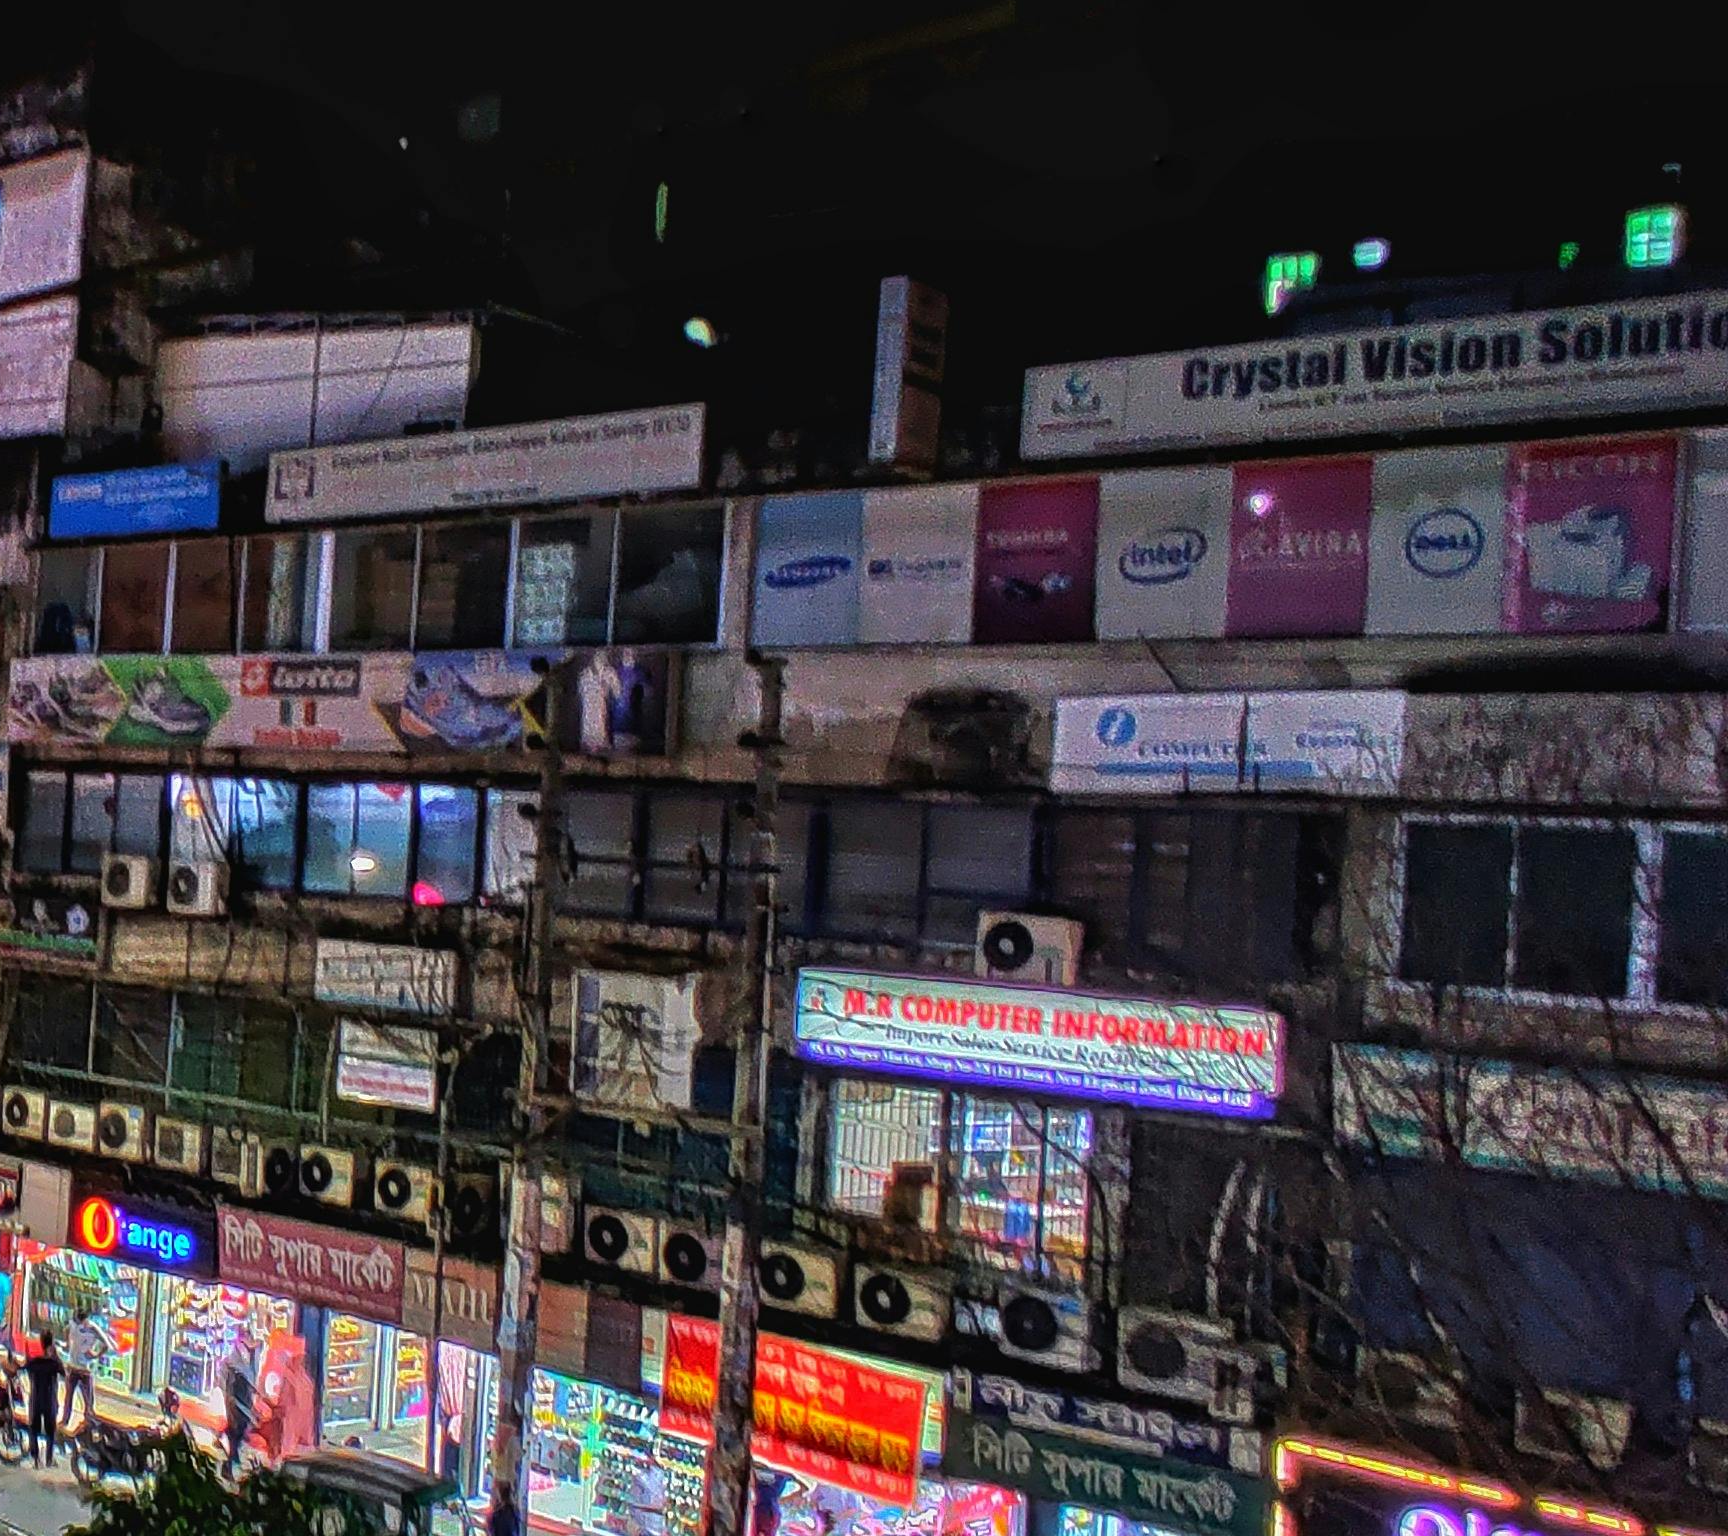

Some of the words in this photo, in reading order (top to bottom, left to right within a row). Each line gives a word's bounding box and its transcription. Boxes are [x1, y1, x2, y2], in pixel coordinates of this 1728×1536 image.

[1180, 344, 1347, 402] Crystal
[1362, 328, 1522, 382] Vision
[901, 993, 1042, 1036] COMPUTER
[1052, 1010, 1267, 1057] INFORMATION
[223, 1214, 264, 1261] সিটি
[268, 1232, 323, 1277] সুপার
[328, 1244, 393, 1294] মার্কেট
[972, 1423, 1033, 1474] সিটি
[1039, 1448, 1125, 1500] সুপার
[1132, 1468, 1237, 1524] মার্কেট
